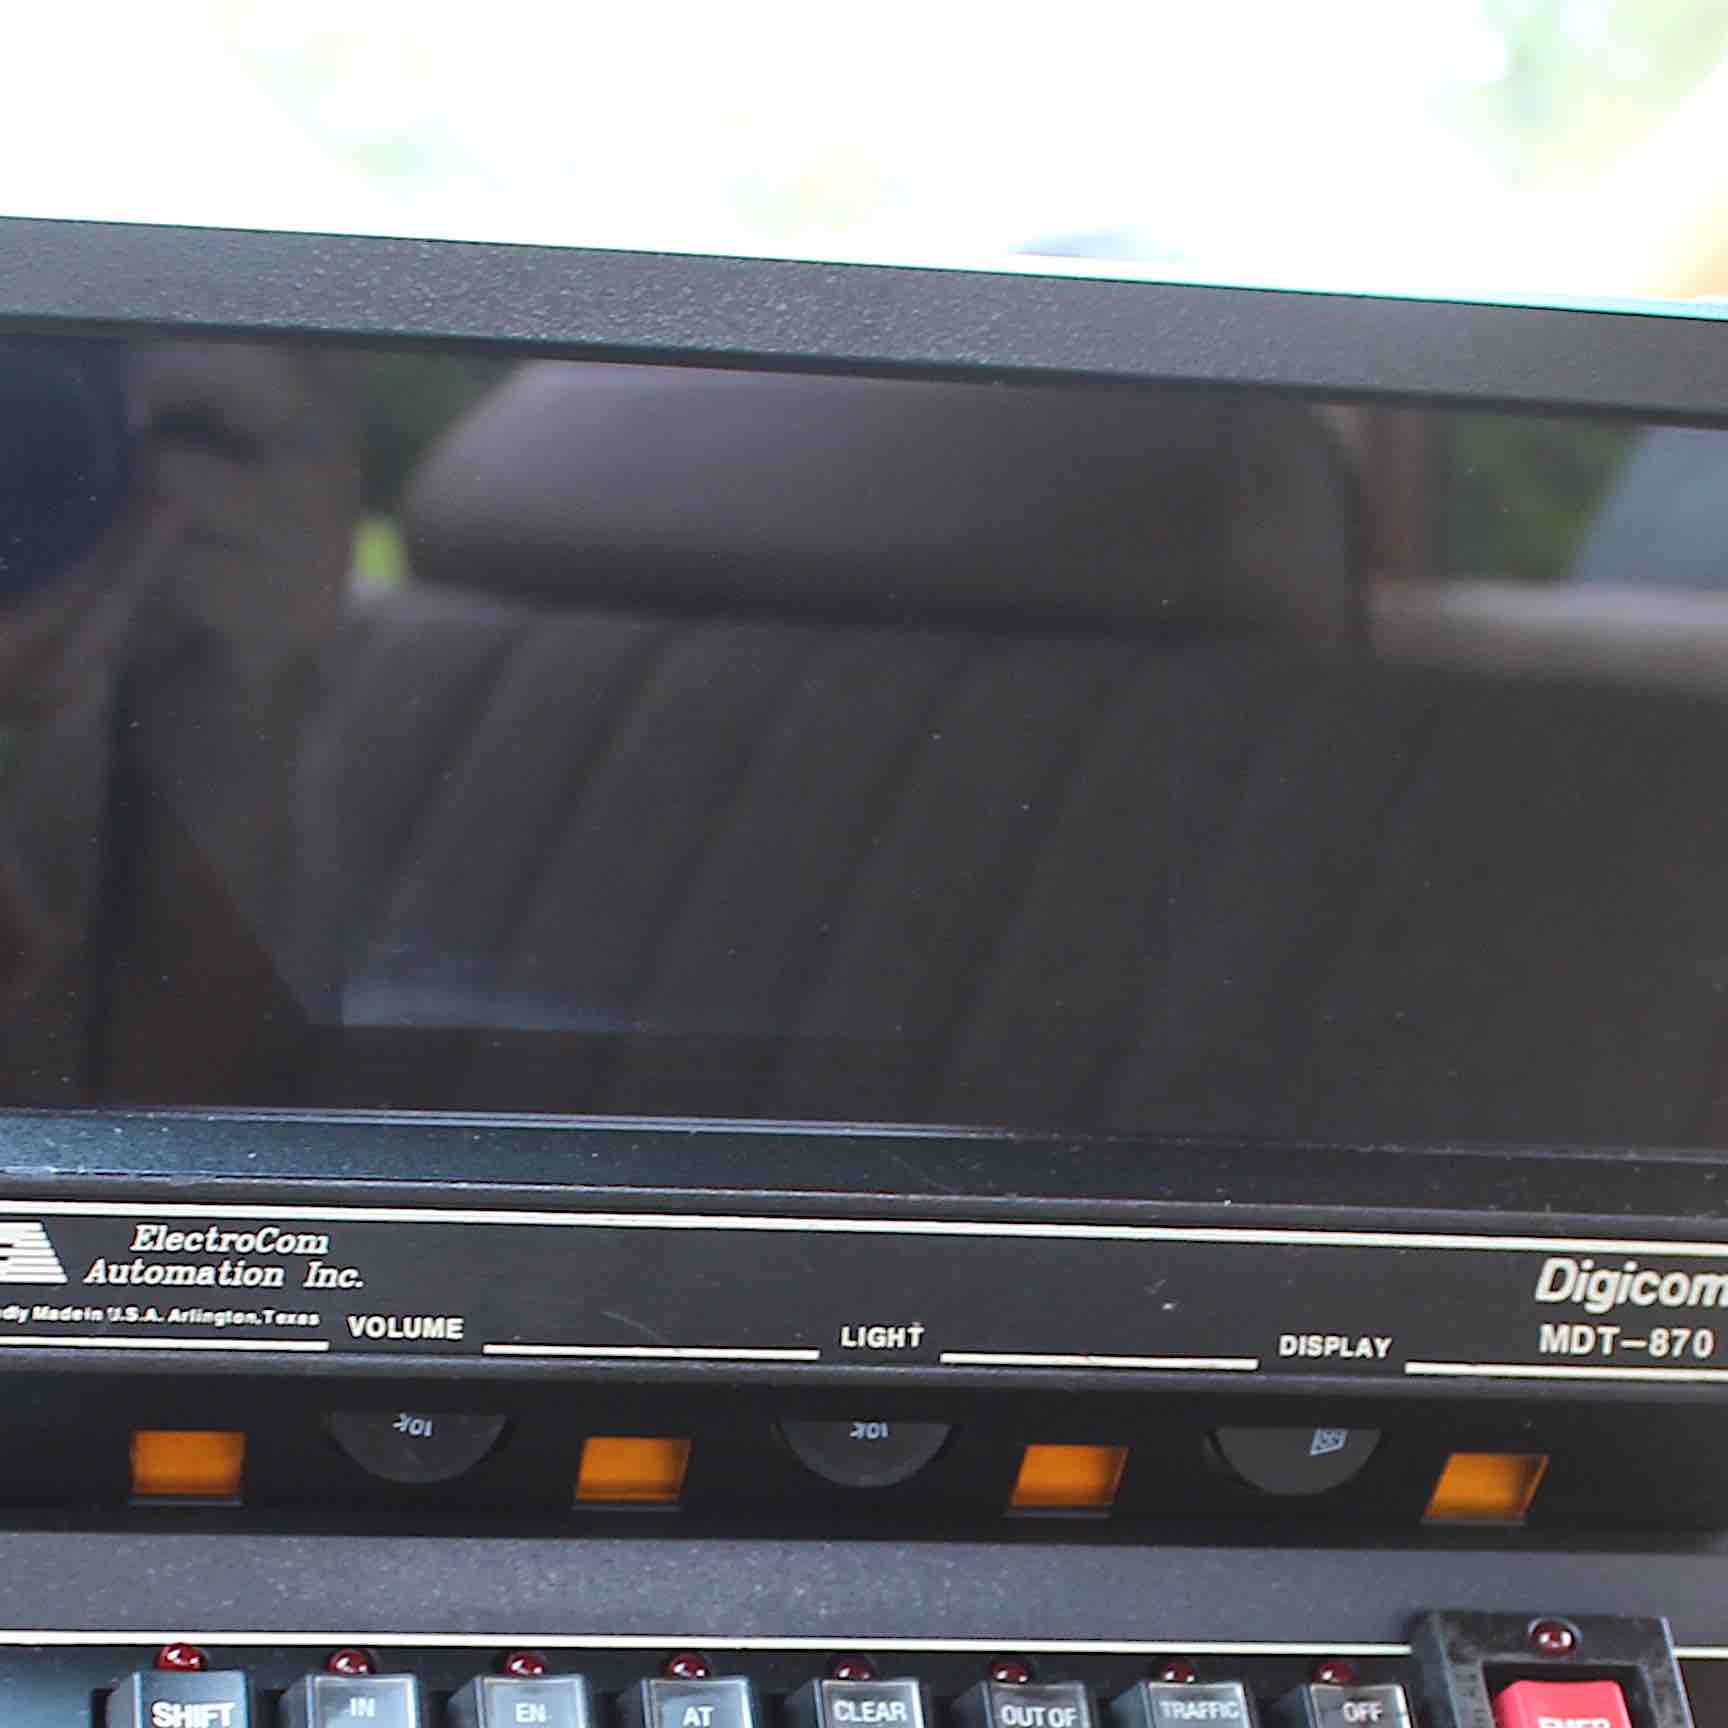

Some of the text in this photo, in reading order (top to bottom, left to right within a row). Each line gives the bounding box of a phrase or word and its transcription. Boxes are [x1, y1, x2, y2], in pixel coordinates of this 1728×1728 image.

[130, 1224, 330, 1256] ElectroCom
[83, 1259, 365, 1290] Automation Inc.
[106, 1306, 165, 1324] U.S.A.
[346, 1315, 464, 1341] VOLUME
[841, 1323, 925, 1348] LIGHT
[1279, 1335, 1392, 1359] DISPLAY
[1538, 1324, 1714, 1359] MDT-870
[349, 1698, 375, 1718] IN
[515, 1703, 547, 1724] EN
[683, 1706, 713, 1727] AT
[833, 1700, 909, 1724] CLEAR
[1000, 1704, 1045, 1728] OUT
[1160, 1700, 1241, 1720] TRAFFIC
[1343, 1702, 1384, 1724] OFF
